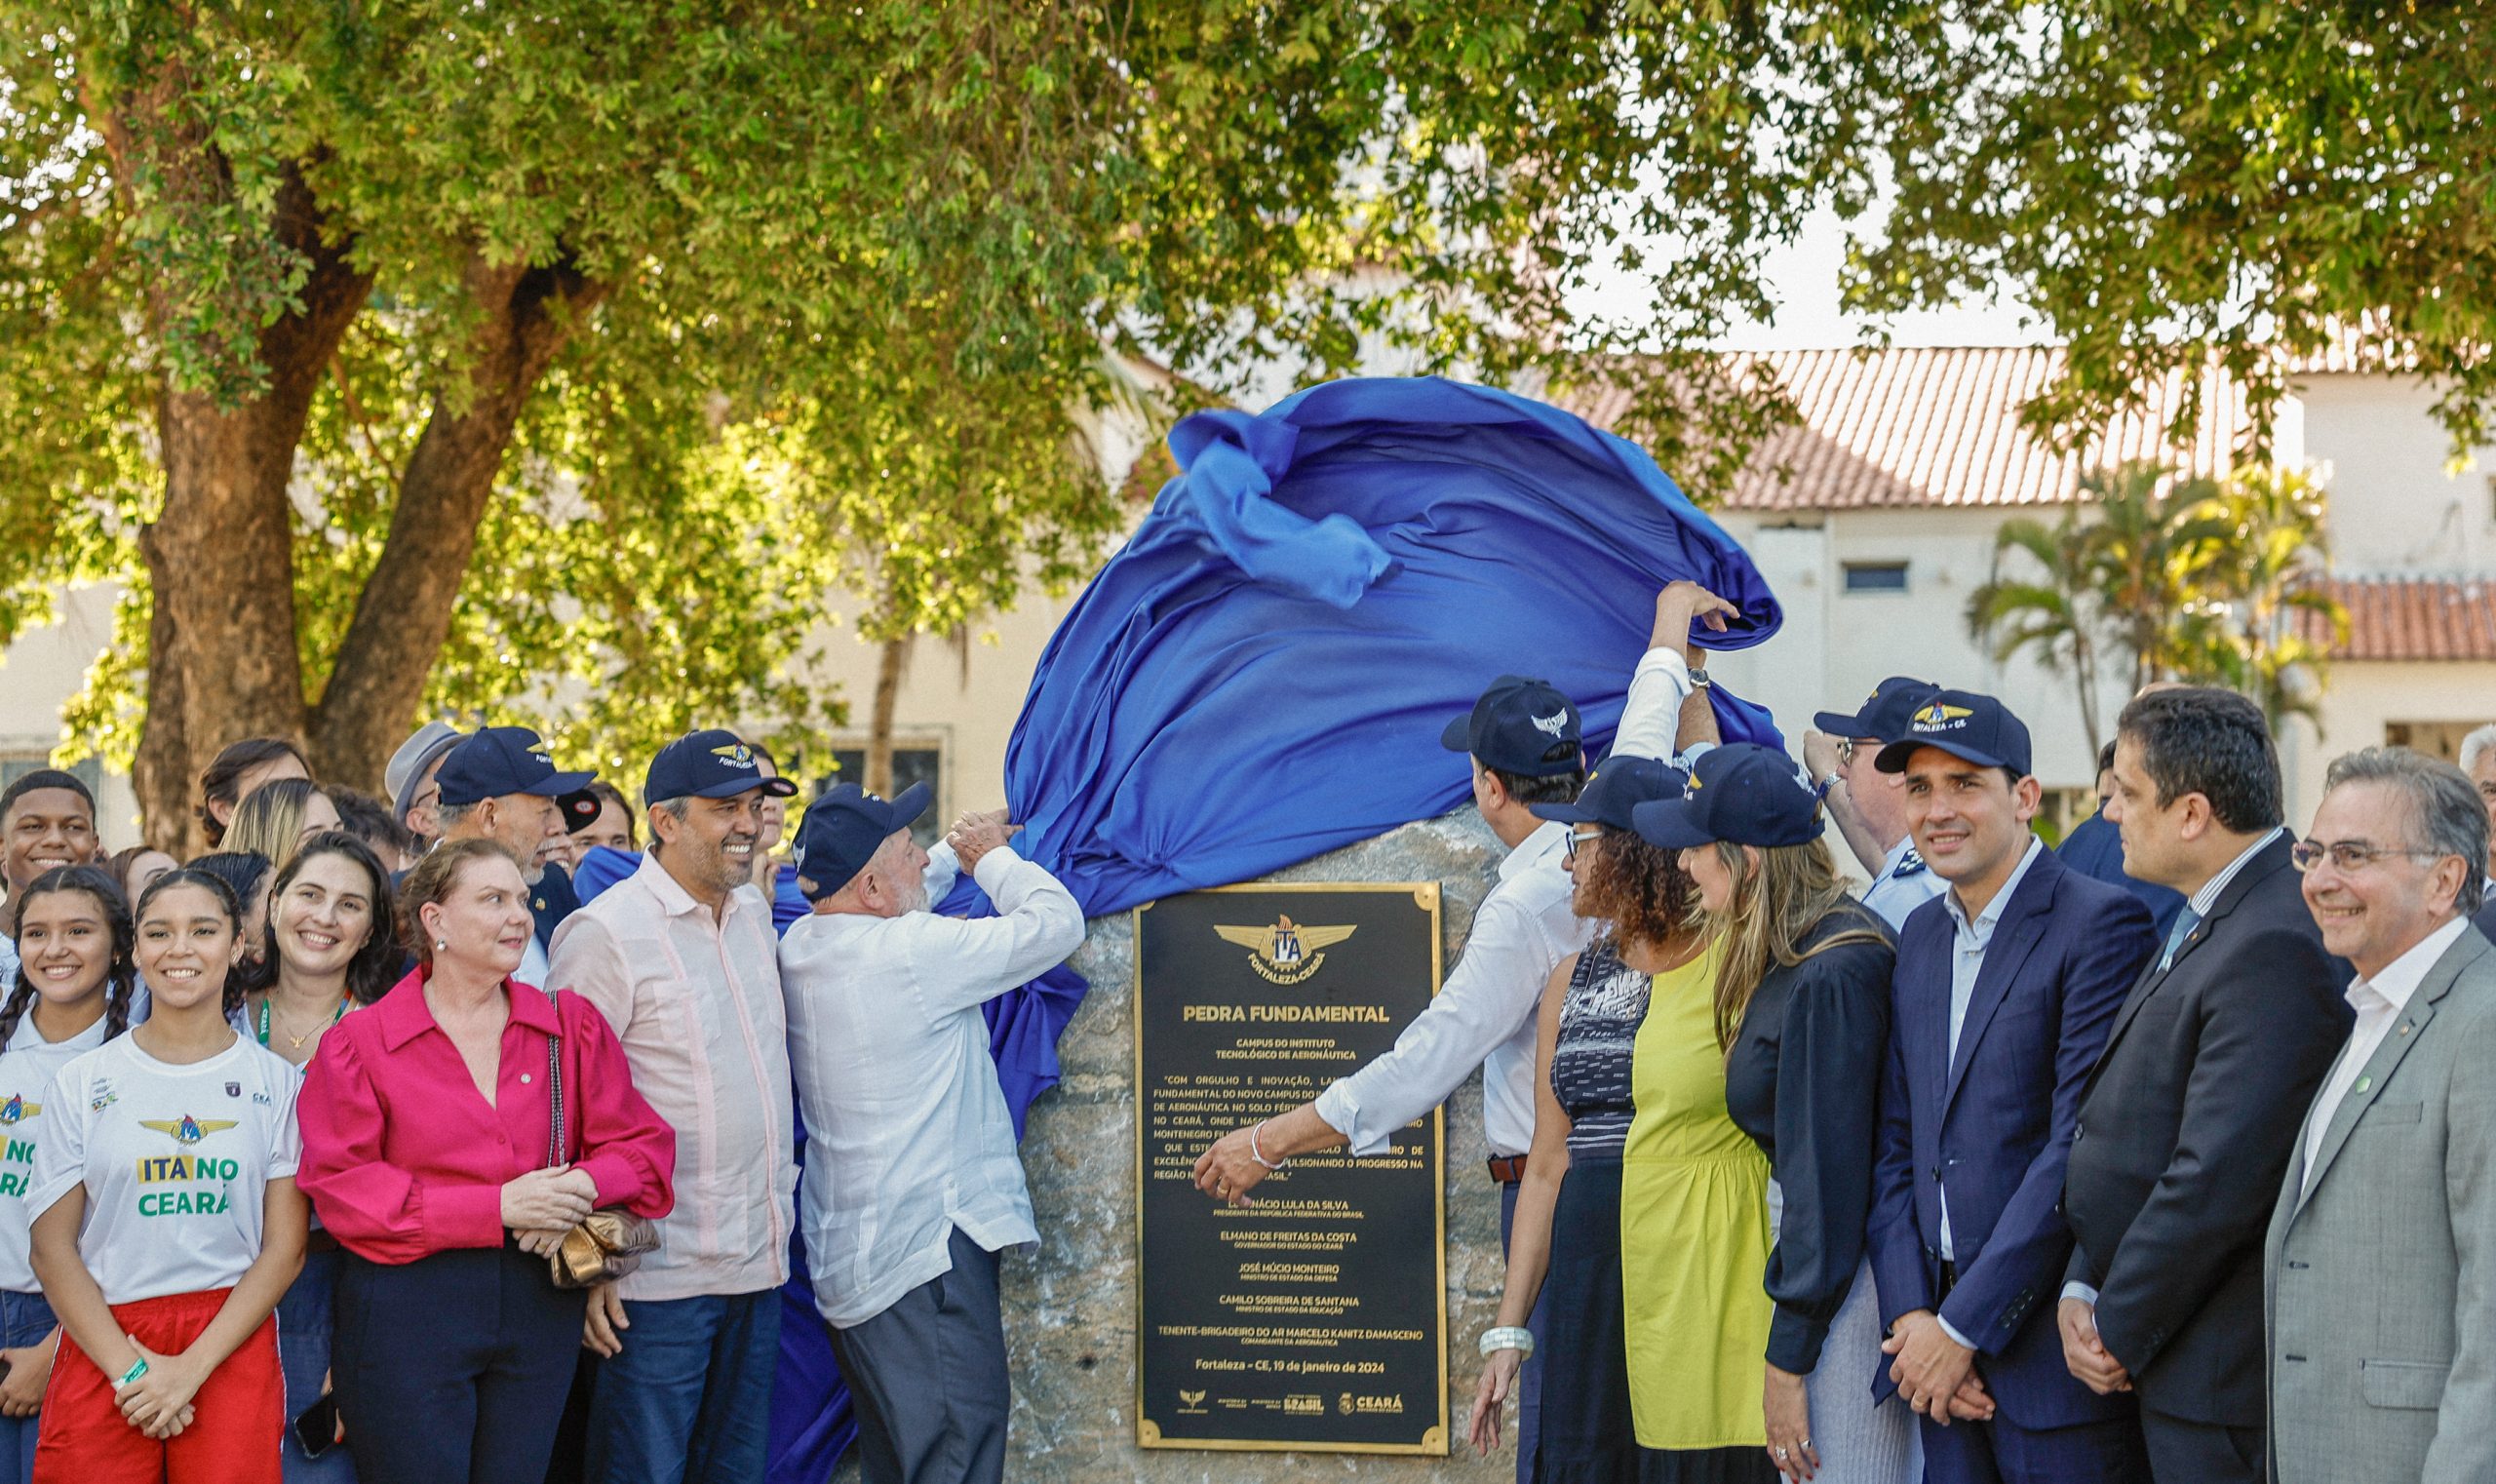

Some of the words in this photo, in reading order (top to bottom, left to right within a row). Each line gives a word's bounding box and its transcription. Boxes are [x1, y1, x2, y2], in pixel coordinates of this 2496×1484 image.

[1274, 930, 1303, 960] ITA
[1183, 1005, 1246, 1023] PEDRA
[1250, 1005, 1390, 1023] FUNDAMENTAL
[1236, 1038, 1273, 1049] CAMPUS
[1274, 1038, 1288, 1048] DO
[1289, 1038, 1336, 1048] INSTITUTO
[1216, 1048, 1279, 1060] TECNOLÓGICO
[1279, 1050, 1291, 1060] DE
[1292, 1048, 1356, 1061] AERONÁUTICA
[1195, 1075, 1239, 1085] ORGULHO
[1247, 1075, 1254, 1085] E
[1261, 1074, 1313, 1088] INOVAÇÃO,
[1153, 1089, 1221, 1099] FUNDAMENTAL
[1223, 1089, 1236, 1099] DO
[1237, 1089, 1264, 1099] NOVO
[1265, 1089, 1301, 1099] CAMPUS
[1302, 1090, 1314, 1099] DO
[1153, 1103, 1165, 1113] DE
[1168, 1101, 1229, 1113] AERONÁUTICA
[1232, 1103, 1245, 1113] NO
[1248, 1103, 1271, 1113] SOLO
[1153, 1116, 1167, 1125] NO
[1173, 1114, 1204, 1127] CEARÁ,
[1210, 1116, 1234, 1125] ONDE
[1153, 1130, 1213, 1139] MONTENEGRO
[1164, 1144, 1183, 1154] QUE
[1411, 1146, 1424, 1155] DE
[144, 1157, 188, 1182] ITA
[196, 1158, 239, 1181] NO
[1346, 1159, 1354, 1168] O
[1356, 1159, 1408, 1169] PROGRESSO
[1410, 1160, 1424, 1169] NA
[1153, 1169, 1187, 1180] REGIÃO
[1250, 1197, 1280, 1210] NÁCIO
[1281, 1200, 1306, 1210] LULA
[1306, 1200, 1320, 1210] DA
[1321, 1201, 1348, 1211] SILVA
[1220, 1231, 1259, 1241] ELMANO
[1260, 1231, 1272, 1241] DE
[1273, 1231, 1310, 1242] FREITAS
[1311, 1232, 1325, 1242] DA
[1326, 1232, 1357, 1243] COSTA
[1238, 1262, 1261, 1273] JOSÉ
[1263, 1262, 1291, 1273] MÚCIO
[1292, 1264, 1340, 1274] MONTEIRO
[1219, 1295, 1254, 1305] CAMILO
[1255, 1295, 1300, 1306] SOBREIRA
[1301, 1296, 1313, 1306] DE
[1314, 1296, 1359, 1307] SANTANA
[1158, 1326, 1256, 1337] TENENTE-BRIGADEIRO
[1256, 1327, 1270, 1337] DO
[1271, 1328, 1285, 1337] AR
[1286, 1328, 1330, 1339] MARCELO
[1331, 1329, 1365, 1340] KANITZ
[1366, 1330, 1424, 1341] DAMASCENO
[1195, 1358, 1246, 1371] Fortaleza
[1255, 1360, 1271, 1372] CE,
[1273, 1360, 1285, 1371] 19
[1286, 1360, 1300, 1372] de
[1302, 1360, 1341, 1375] janeiro
[1342, 1361, 1356, 1373] de
[1357, 1362, 1384, 1374] 2024
[1356, 1393, 1403, 1408] CEARÁ
